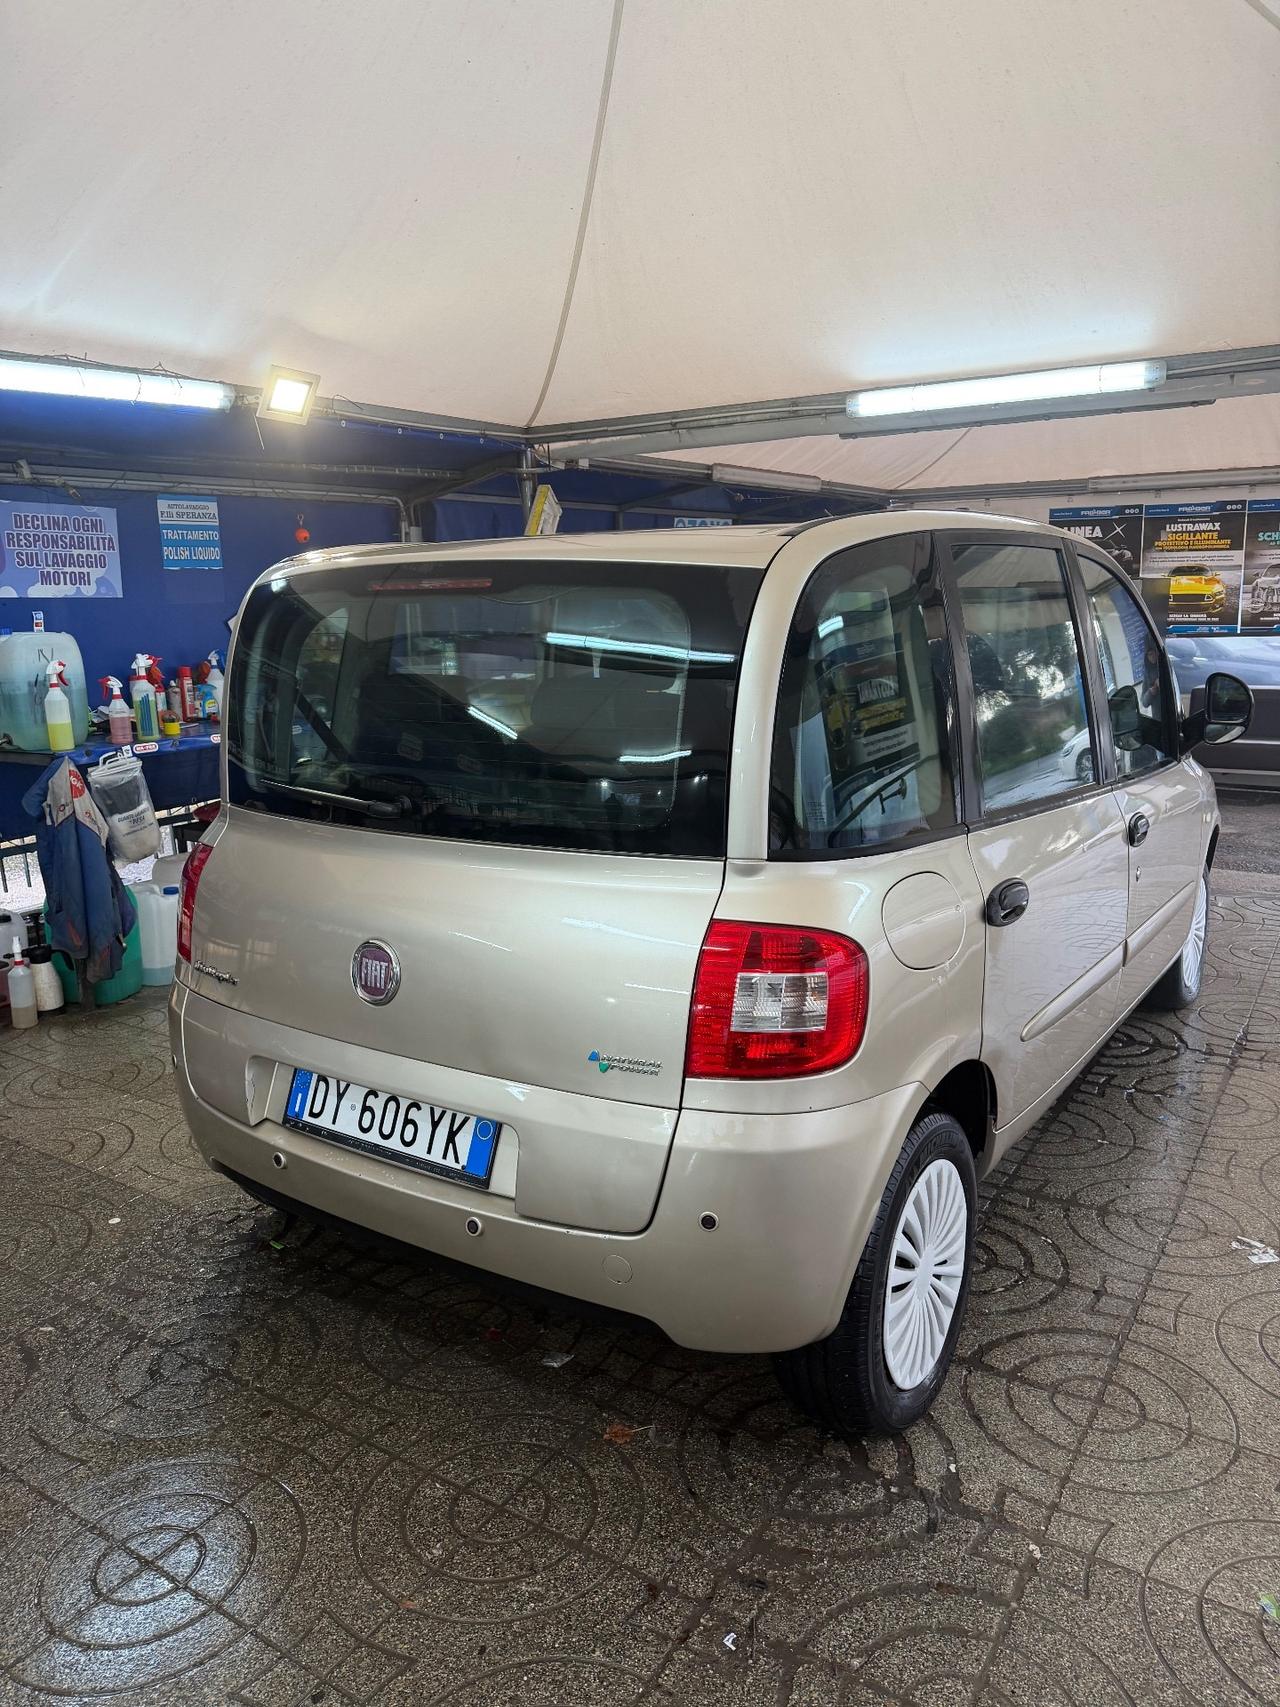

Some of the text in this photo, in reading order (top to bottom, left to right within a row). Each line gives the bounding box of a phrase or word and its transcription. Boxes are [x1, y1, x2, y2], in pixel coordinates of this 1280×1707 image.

[167, 503, 210, 511] AUTOLAVAGGIO
[12, 512, 104, 533] DECLINA OGNI
[175, 511, 217, 520] SPERANZA
[1166, 522, 1221, 532] LUSTRAWAX
[5, 531, 116, 551] RESPONSABILITÀ
[163, 529, 219, 541] TRATTAMENTO
[1167, 531, 1219, 541] SIGILLANTE
[15, 551, 107, 570] SUL LAVAGGIO
[163, 546, 221, 561] POLISH LIQUIDO
[40, 570, 91, 586] MOTORI
[361, 957, 388, 990] FIAT
[601, 1054, 663, 1068] NATURAL
[609, 1063, 660, 1076] POWER
[308, 1074, 351, 1126] DY
[357, 1089, 470, 1165] 606YK
